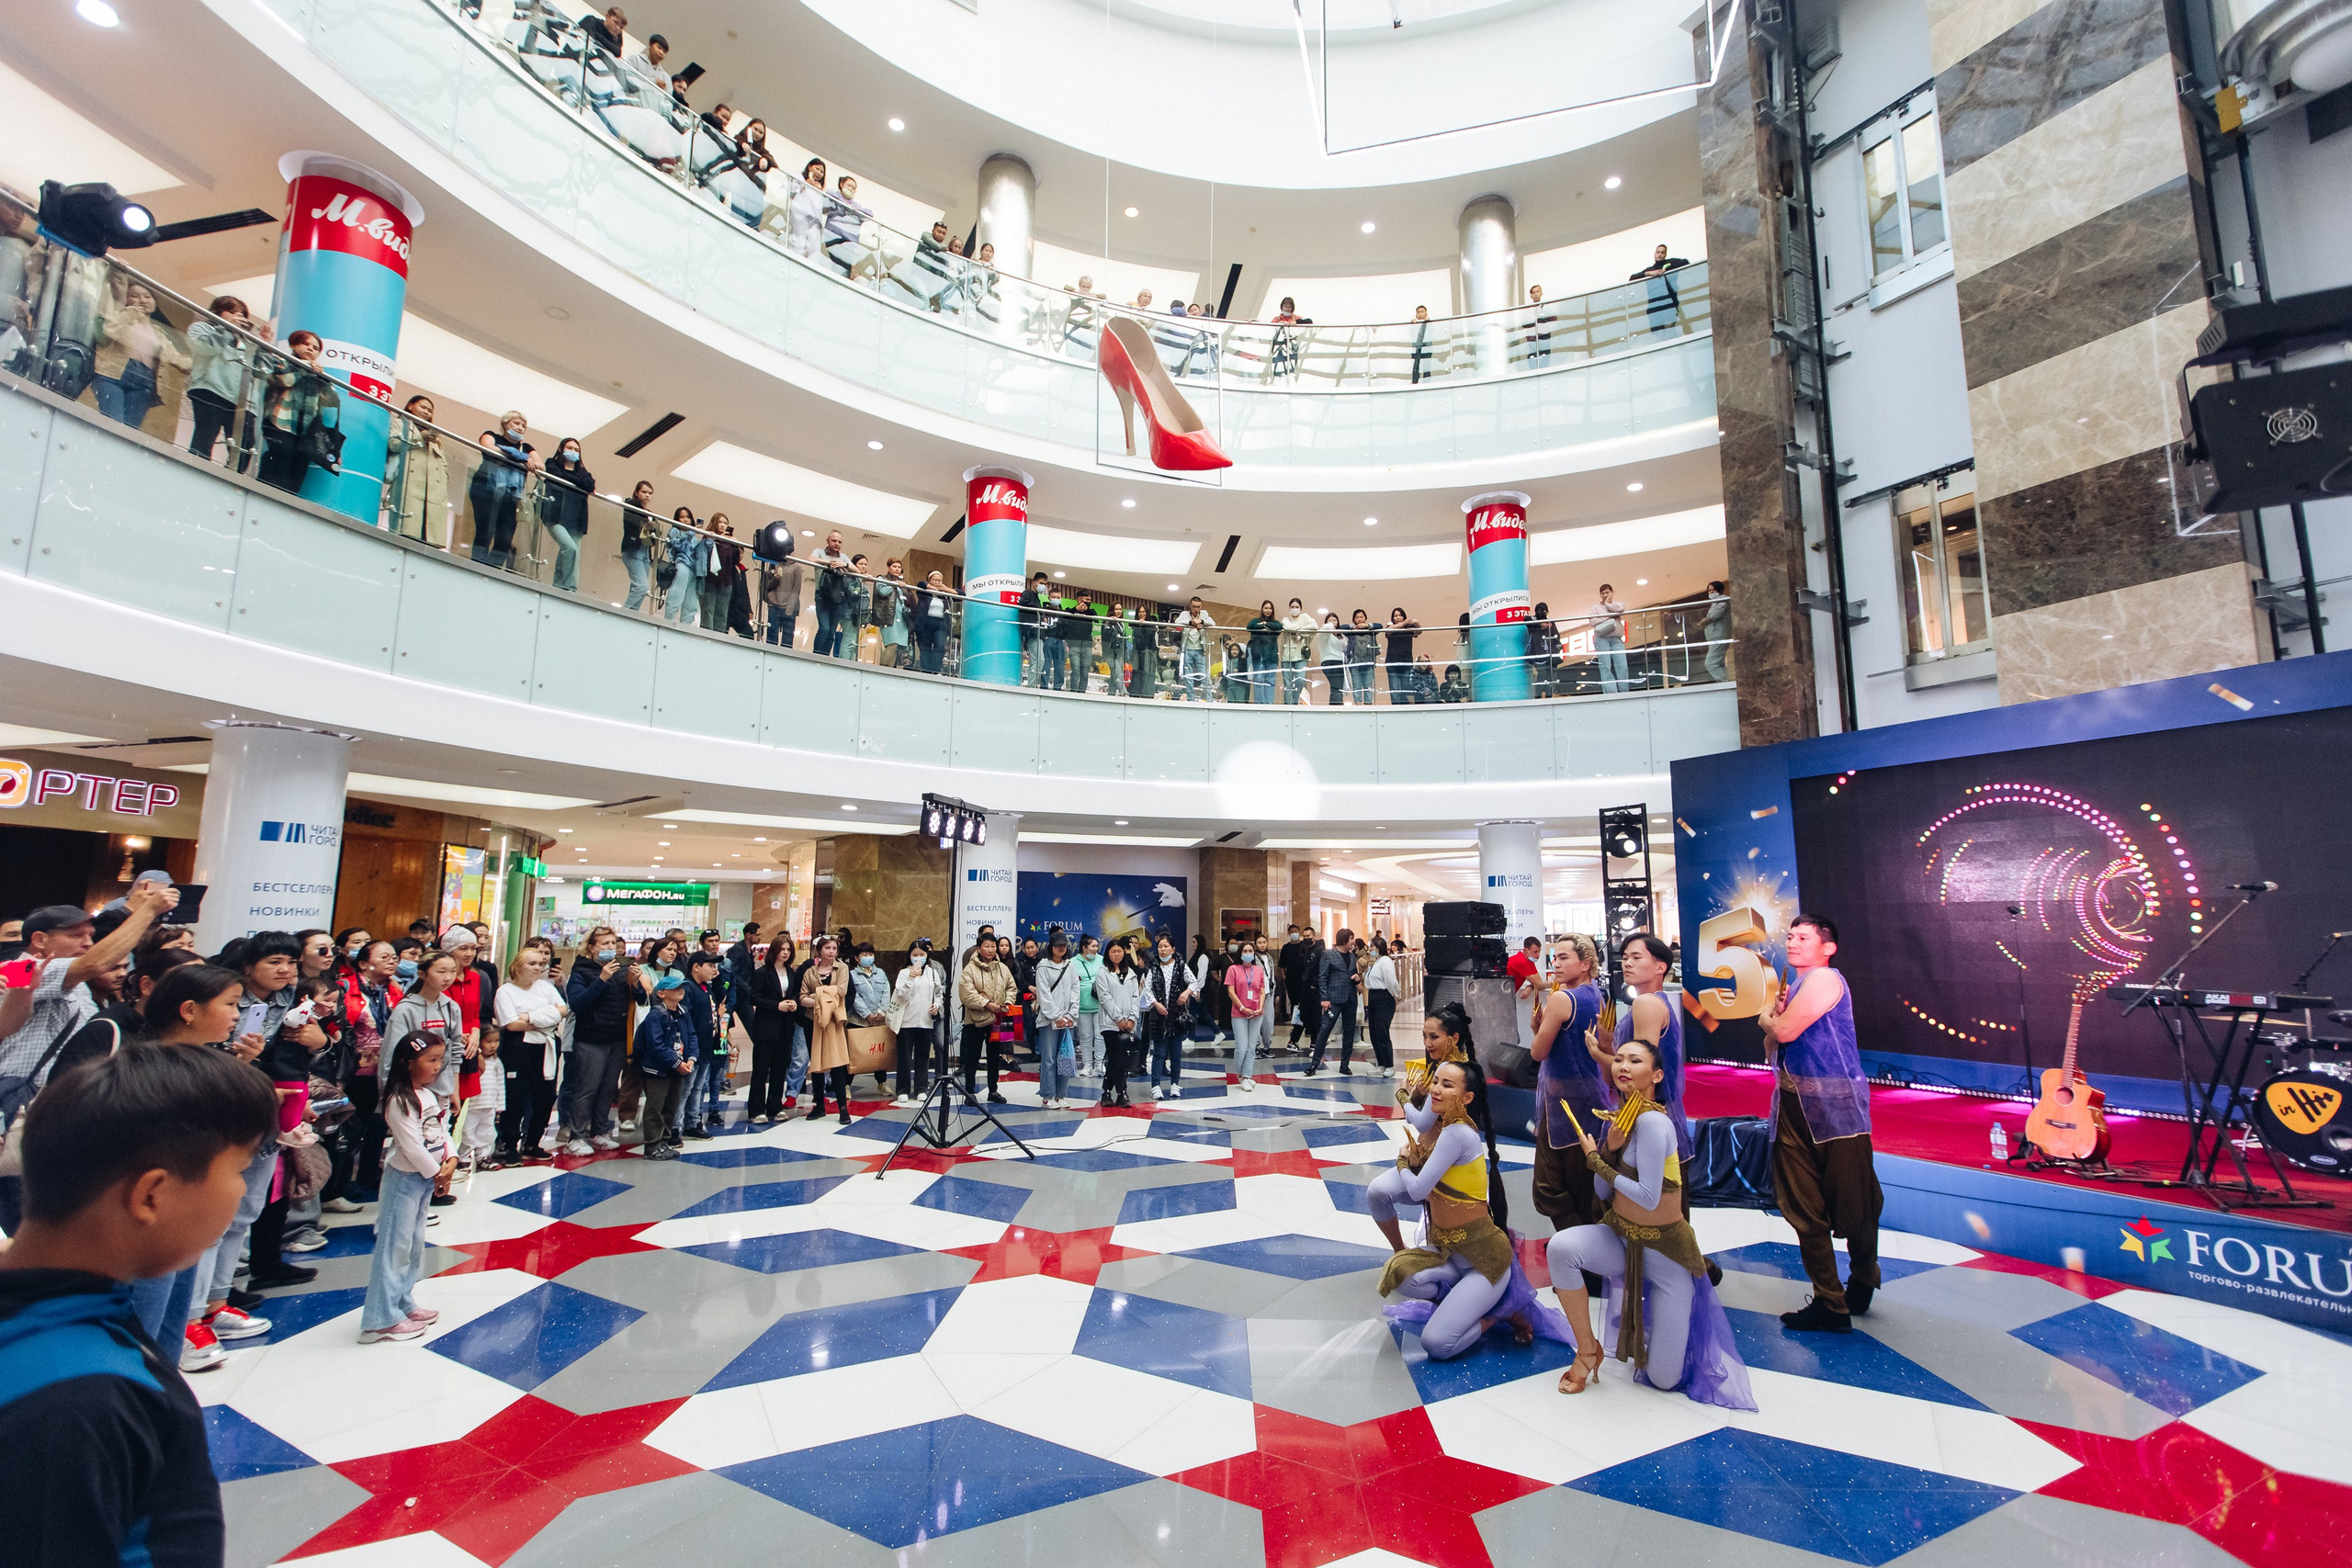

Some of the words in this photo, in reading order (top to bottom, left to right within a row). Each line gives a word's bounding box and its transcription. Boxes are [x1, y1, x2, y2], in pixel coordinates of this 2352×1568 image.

[311, 193, 411, 264] М.вид
[972, 581, 986, 591] МЫ
[988, 579, 1025, 588] ОТКРЫЛИ
[311, 824, 340, 836] ЧИТА
[309, 834, 338, 847] ГОРО
[1508, 873, 1532, 881] ЧИТАЙ
[249, 906, 321, 917] НОВИНКИ
[1698, 906, 1780, 1021] 5
